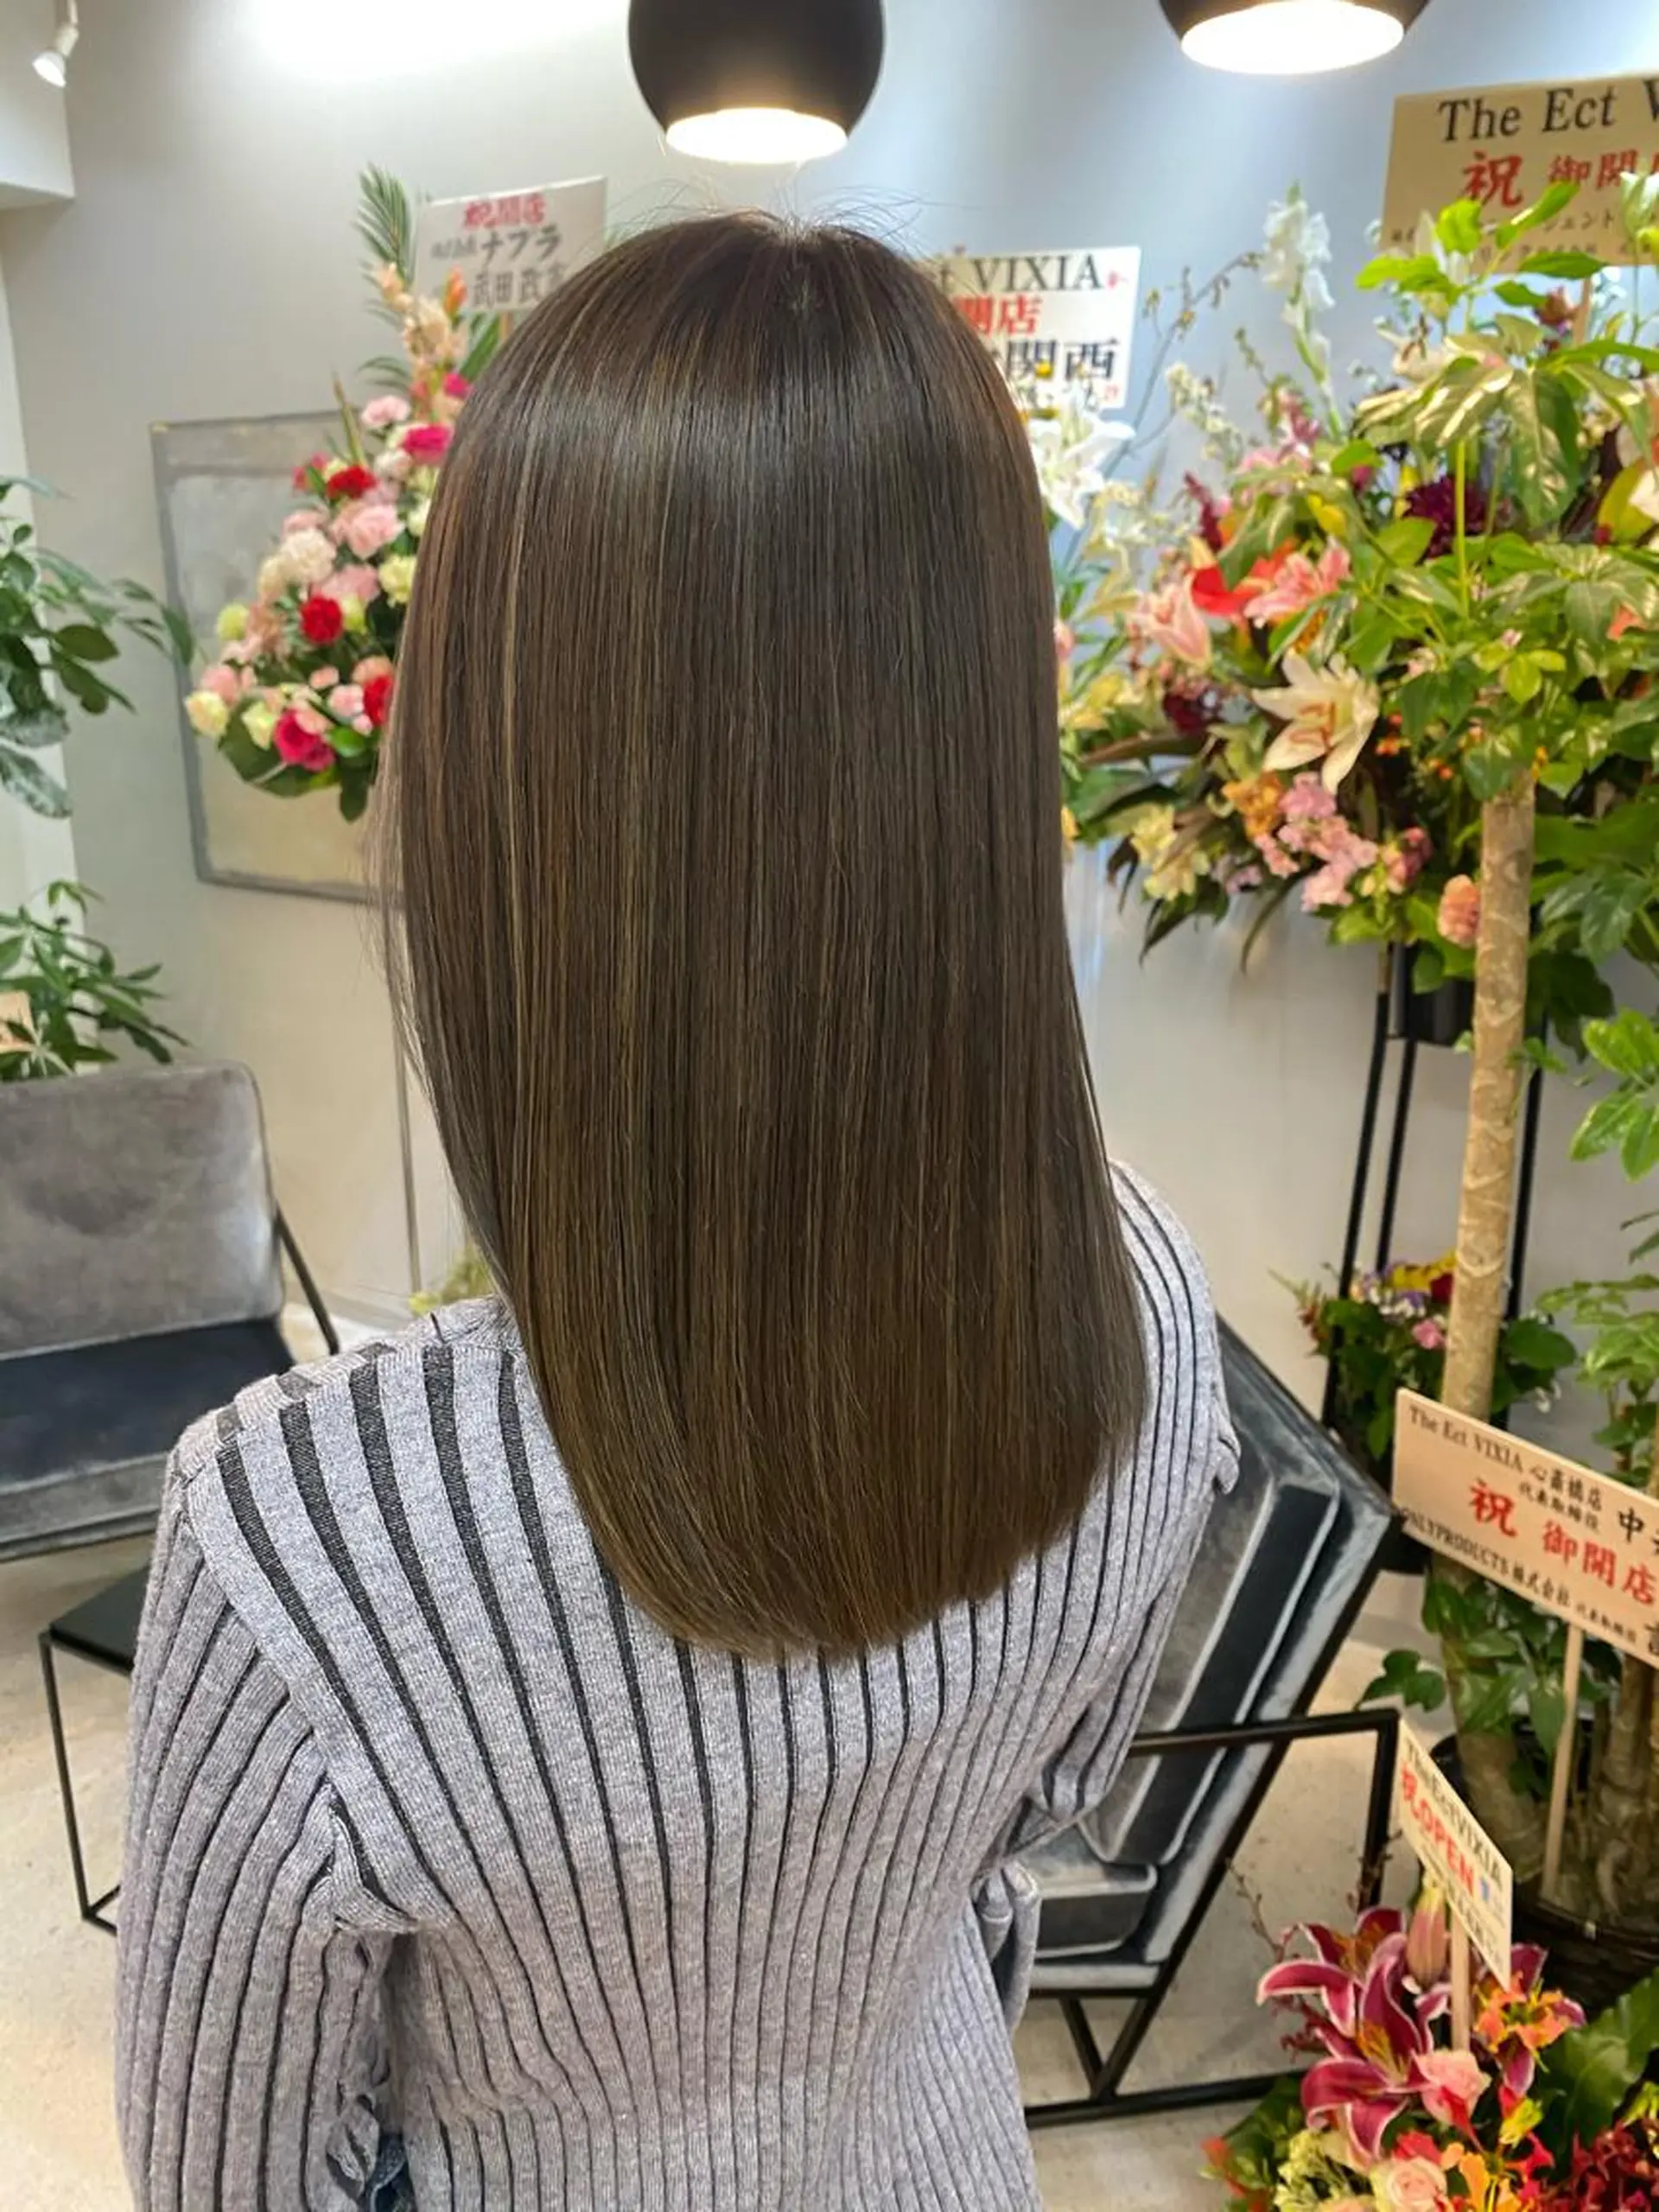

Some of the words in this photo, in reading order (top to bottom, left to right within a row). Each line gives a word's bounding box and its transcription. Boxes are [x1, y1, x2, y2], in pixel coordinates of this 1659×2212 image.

[1438, 98, 1522, 143] The
[1541, 86, 1616, 132] Ect
[1458, 150, 1523, 207] 祝
[969, 254, 1103, 291] VIXIA
[1409, 1406, 1438, 1433] The
[1442, 1417, 1467, 1447] Ect
[1471, 1433, 1524, 1472] VIXIA
[1470, 1477, 1517, 1538] 祝
[1542, 1518, 1657, 1605] 御開店
